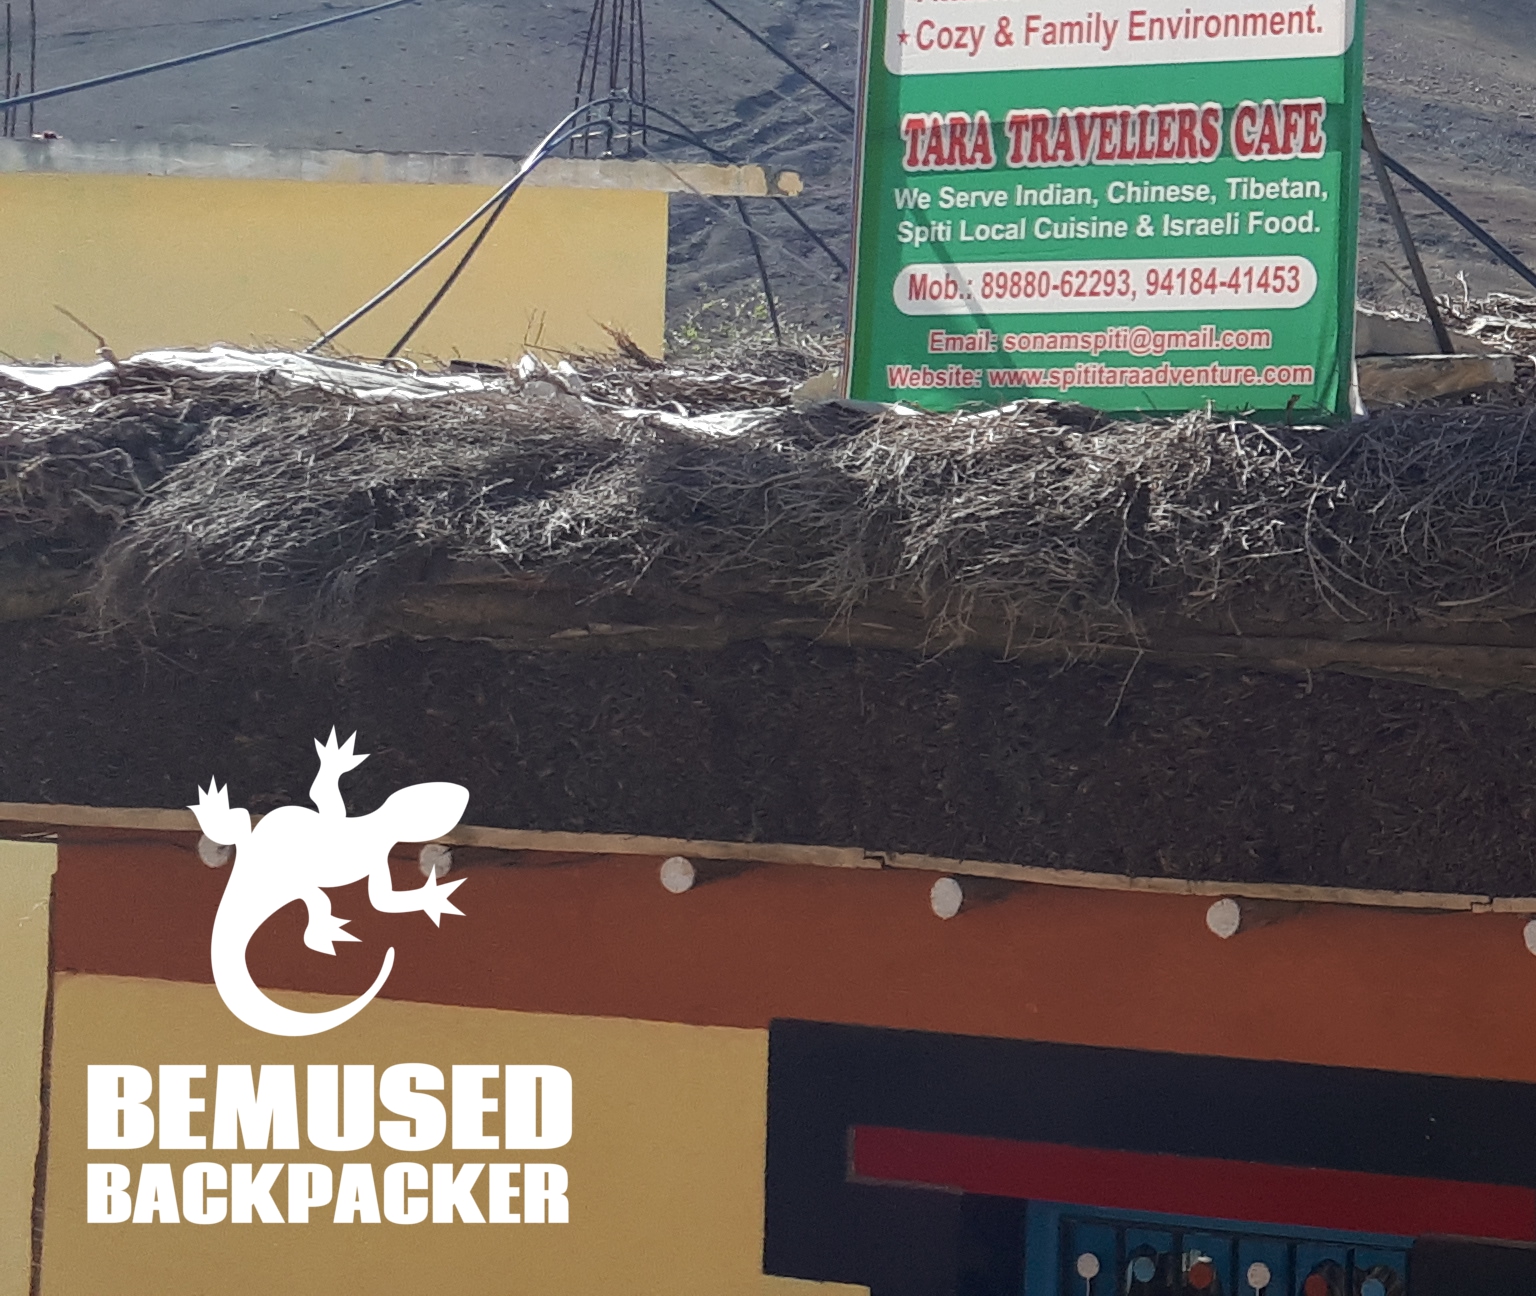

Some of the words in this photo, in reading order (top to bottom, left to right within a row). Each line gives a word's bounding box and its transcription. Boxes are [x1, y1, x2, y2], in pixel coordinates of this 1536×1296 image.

[915, 19, 985, 57] Cozy
[994, 16, 1014, 48] &
[1025, 12, 1118, 51] Family
[1128, 3, 1323, 42] Environment.
[901, 111, 996, 172] TARA
[1005, 101, 1223, 169] TRAVELLERS
[1231, 97, 1327, 161] CAFE
[894, 187, 931, 211] We
[939, 187, 1009, 208] Serve
[1015, 184, 1098, 208] Indian,
[1107, 179, 1217, 205] Chinese,
[1225, 176, 1328, 202] Tibetan,
[898, 220, 952, 247] Spiti
[960, 217, 1026, 241] Local
[1034, 216, 1128, 240] Cuisine
[1135, 214, 1155, 238] &
[1163, 211, 1240, 236] Israeli
[1249, 210, 1320, 235] Food.
[908, 272, 973, 302] Mob.:
[981, 269, 1138, 302] 89880-62293,
[1146, 265, 1300, 297] 94184-41453
[928, 329, 998, 353] Email:
[1003, 325, 1272, 356] sonamspiti@gmail.com
[886, 364, 982, 389] Website:
[988, 362, 1315, 391] www.spititaraadventure.com
